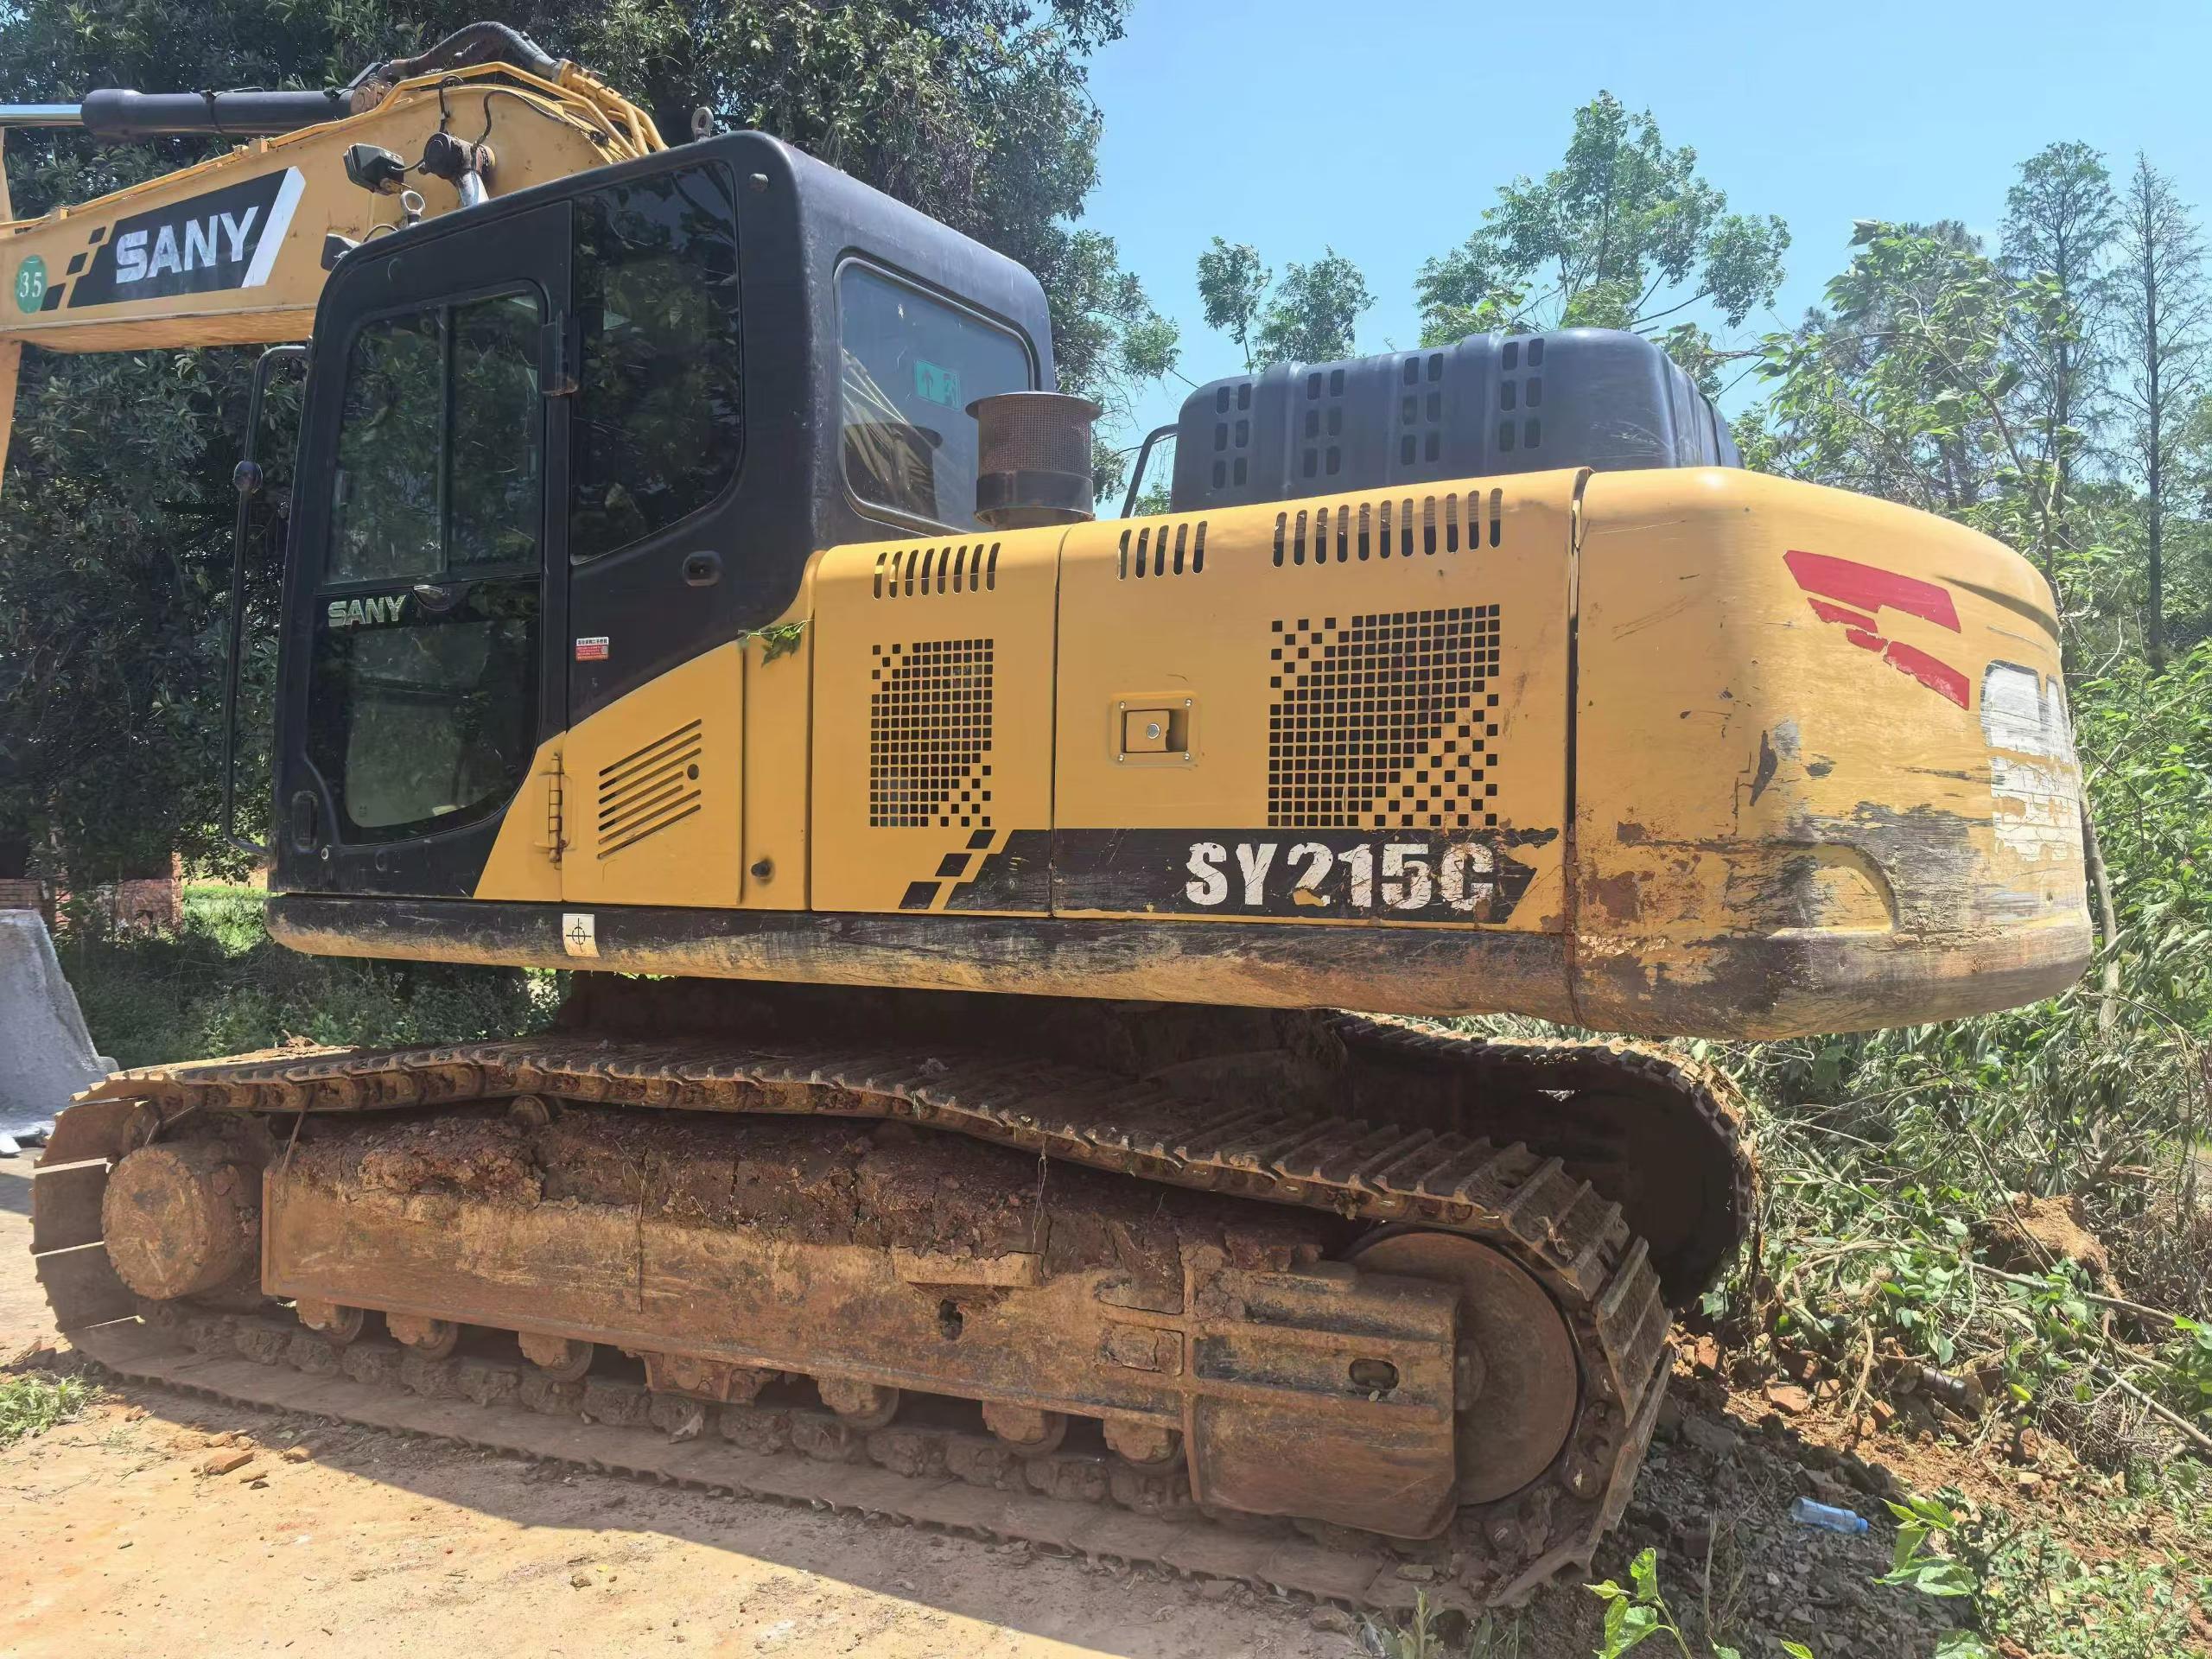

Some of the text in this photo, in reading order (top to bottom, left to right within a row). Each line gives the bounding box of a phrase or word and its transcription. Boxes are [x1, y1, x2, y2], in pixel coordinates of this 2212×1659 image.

[116, 207, 259, 284] SANY
[19, 270, 42, 297] 35
[327, 595, 407, 627] SANY
[1185, 842, 1494, 912] SY215C
